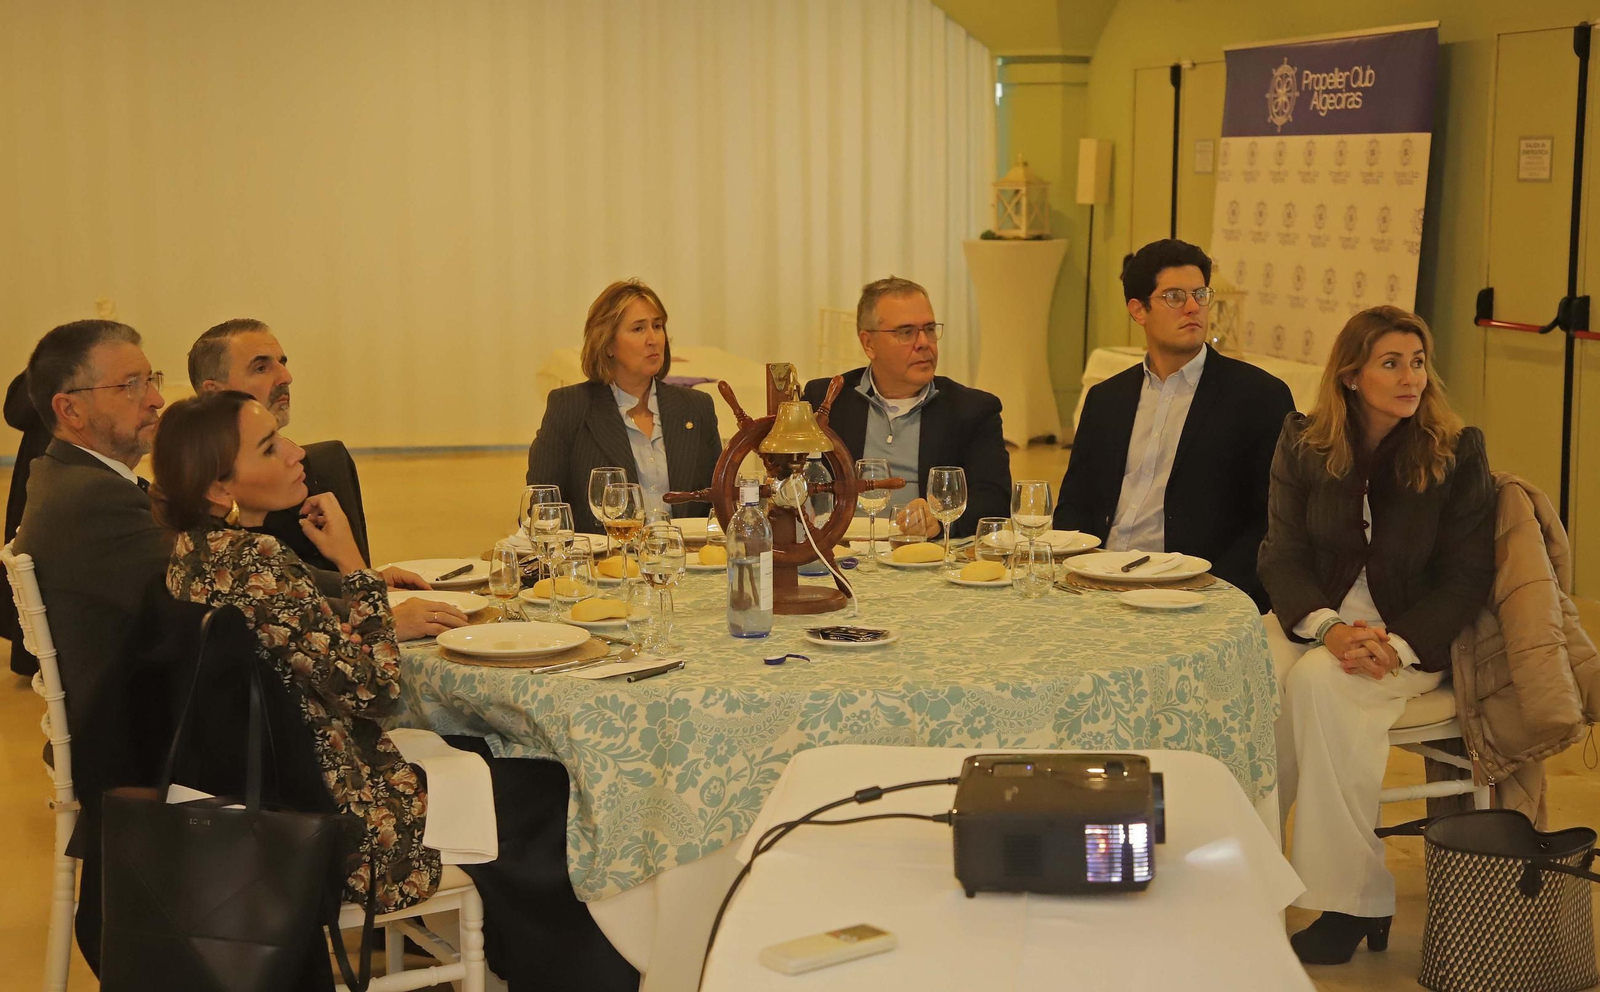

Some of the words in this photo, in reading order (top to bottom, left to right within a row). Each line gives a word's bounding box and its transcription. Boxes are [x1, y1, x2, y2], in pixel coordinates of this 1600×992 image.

[1302, 67, 1350, 91] Propeller
[1350, 65, 1375, 88] Club
[1310, 89, 1363, 116] Algeciras
